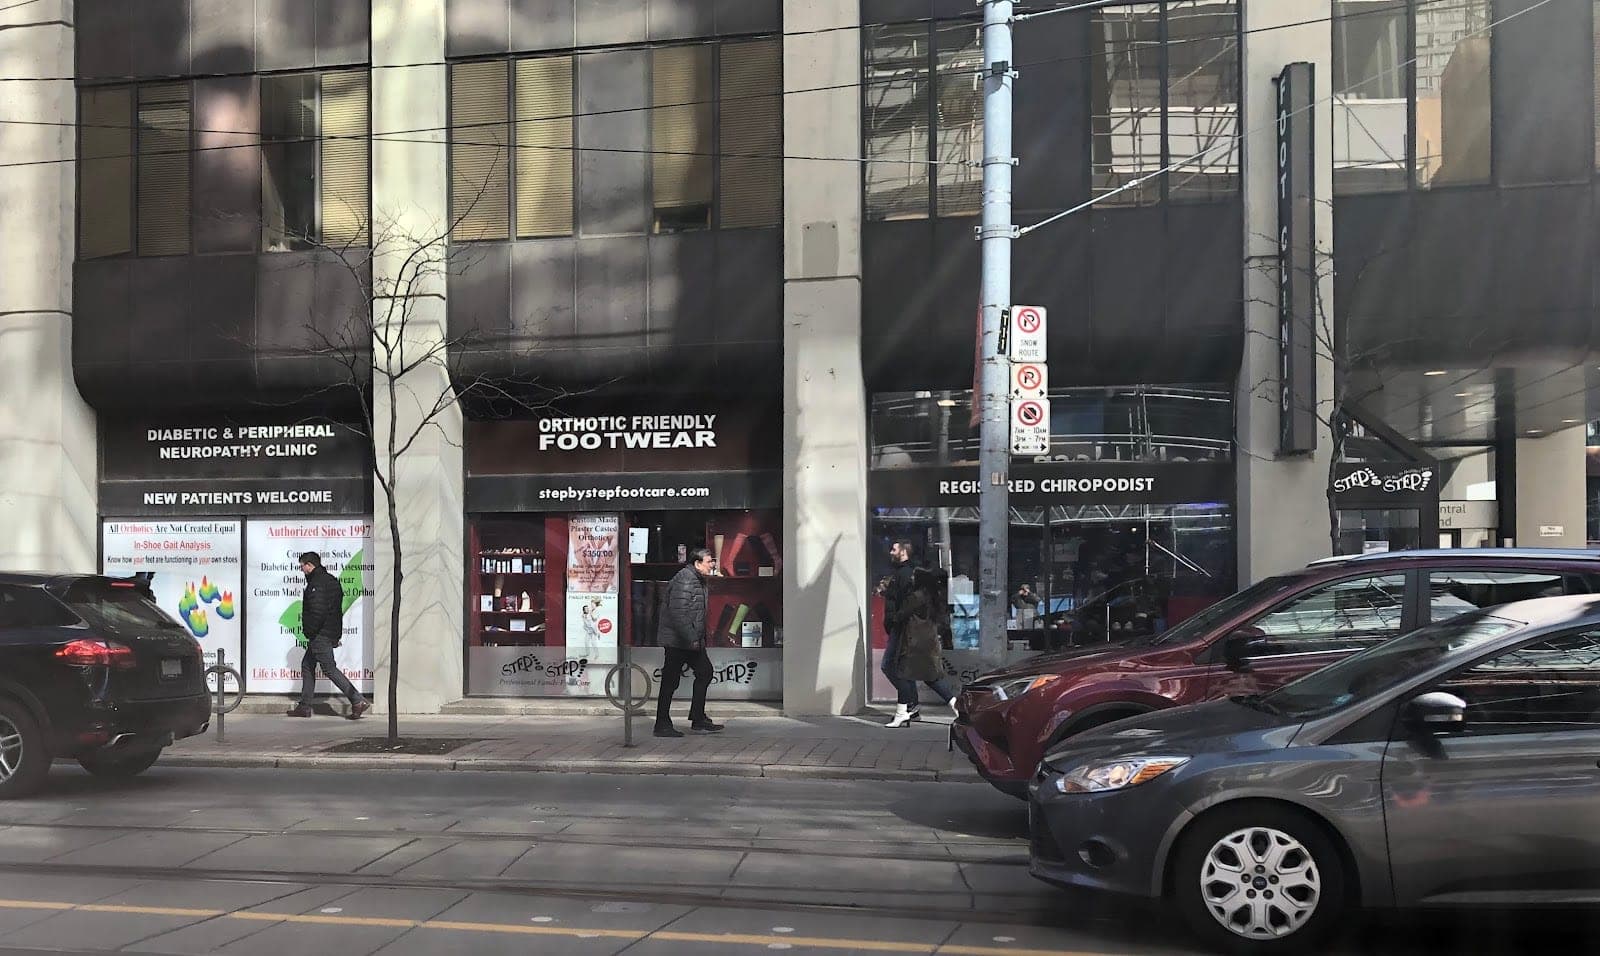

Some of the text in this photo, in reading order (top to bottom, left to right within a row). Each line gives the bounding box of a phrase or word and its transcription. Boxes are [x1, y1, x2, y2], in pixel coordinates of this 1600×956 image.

[1280, 226, 1289, 412] CLINIC
[1018, 349, 1039, 357] ROUTE
[539, 414, 716, 432] ORTHOTIC FRIENDLY
[147, 424, 335, 441] DIABETIC & PERIPHERAL
[539, 430, 717, 451] FOOTWEAR
[160, 443, 318, 459] NEUROPATHY CLINIC
[939, 477, 1155, 494] REGISRED CHIROPODIST
[1334, 470, 1370, 493] STEP
[1383, 473, 1422, 493] STEP
[143, 490, 333, 505] NEW PATIENTS WELCOME
[538, 485, 710, 502] stepbystepfootcare.com
[1440, 504, 1466, 514] ntral
[109, 523, 236, 535] All Orthotics Are Not Created Equal
[268, 524, 371, 537] Authorized Since 1997
[134, 540, 211, 551] In-Shoe Gait Analysis
[331, 549, 352, 558] Socks
[260, 563, 288, 571] Diabetic
[341, 563, 375, 571] Assessmen
[283, 575, 306, 586] Orthop
[254, 588, 280, 597] Custom
[282, 588, 300, 597] Made
[352, 588, 375, 597] Ortho
[252, 667, 269, 679] Life
[270, 667, 278, 679] is
[363, 668, 374, 679] Pa
[502, 655, 579, 678] STEP STEP
